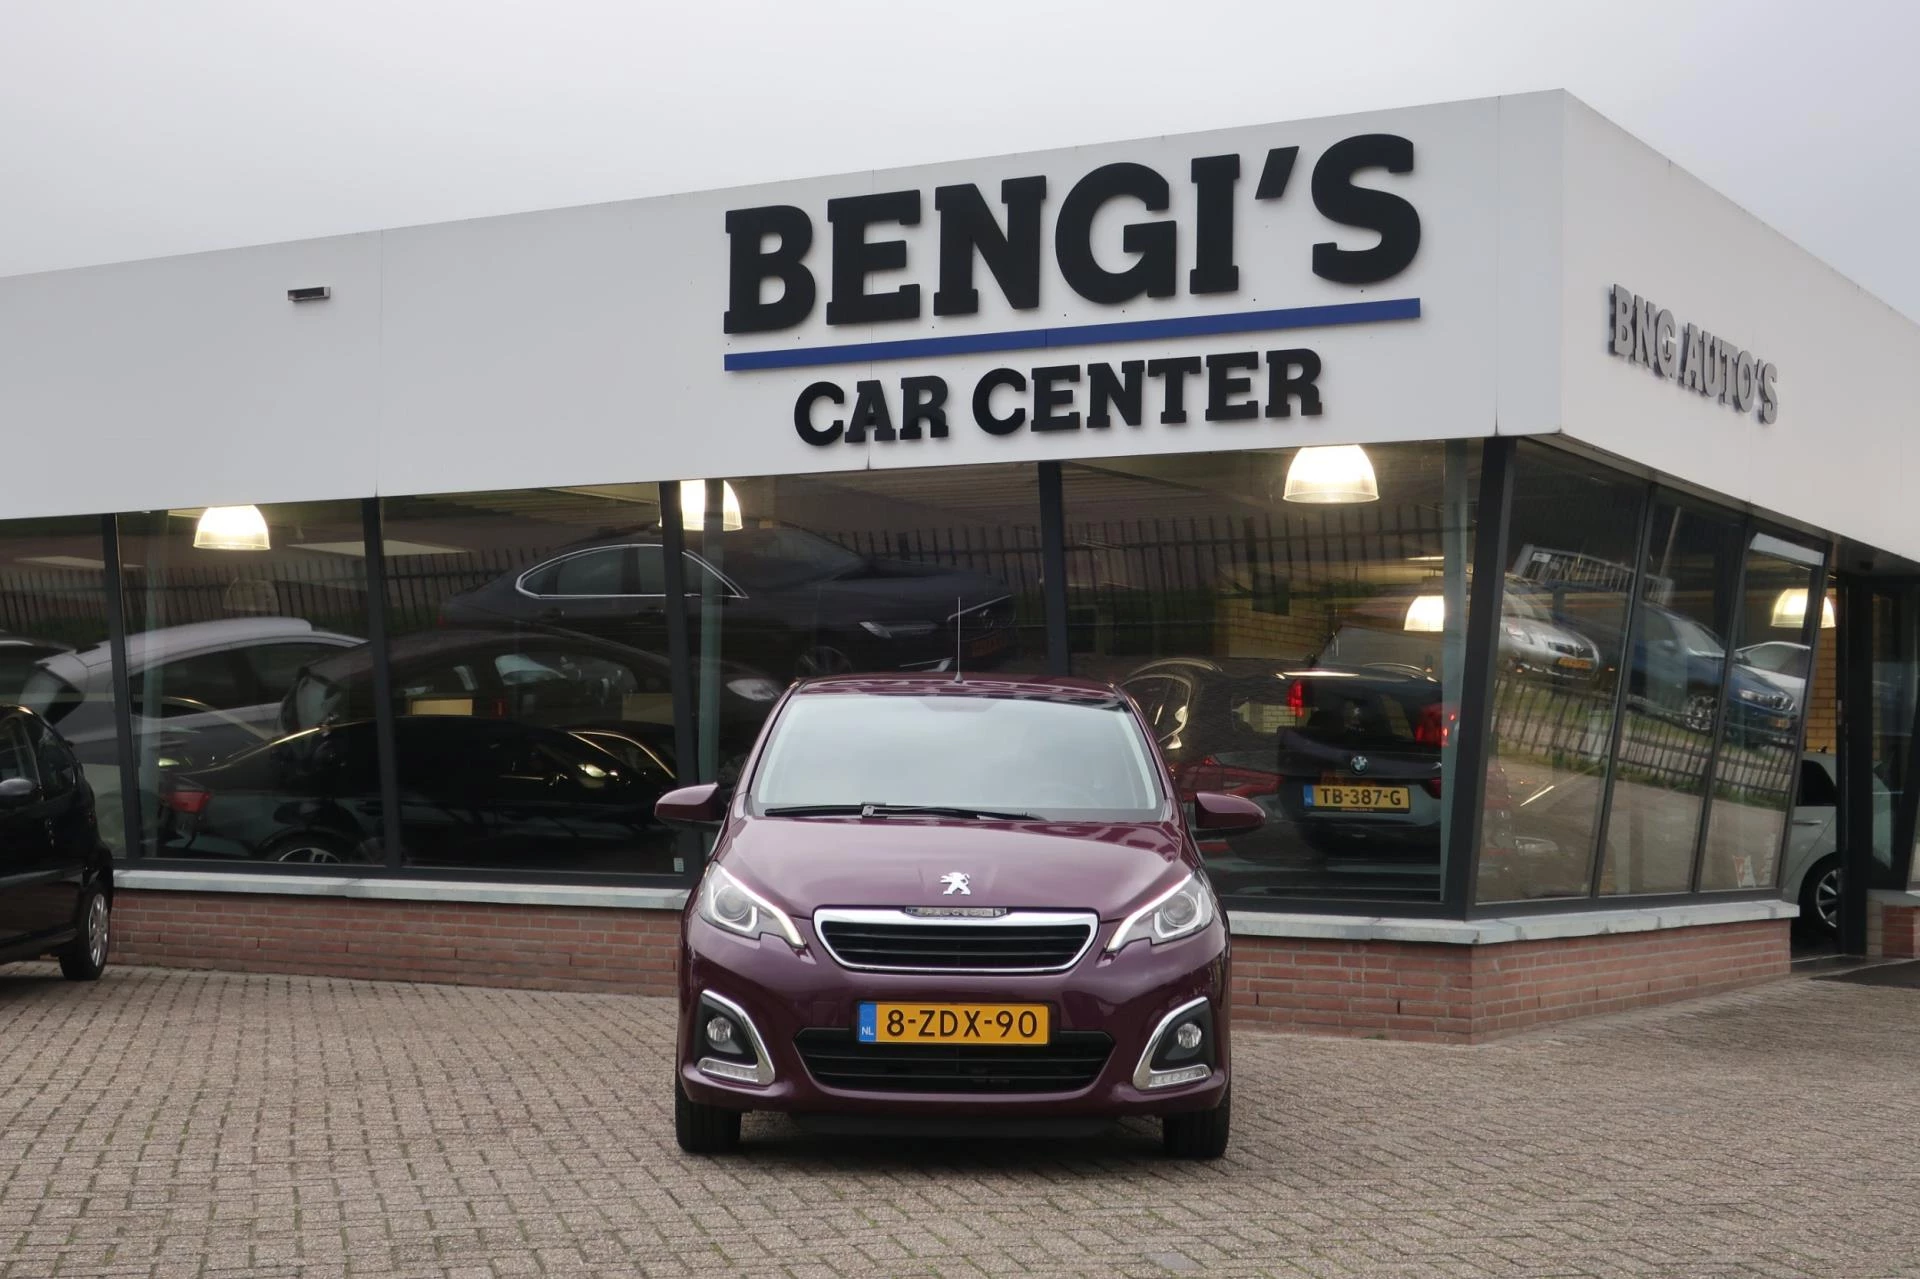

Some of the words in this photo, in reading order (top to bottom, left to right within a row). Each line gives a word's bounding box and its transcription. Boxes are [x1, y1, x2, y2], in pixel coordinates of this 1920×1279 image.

[723, 133, 1421, 335] BENGI'S
[794, 375, 949, 447] CAR
[972, 348, 1323, 435] CENTER
[1609, 283, 1677, 380] BNG
[1679, 322, 1778, 425] AUTO'S
[1320, 788, 1401, 806] TB-387-G
[861, 1026, 874, 1036] NL
[886, 1009, 1038, 1038] 8-ZDX-90
